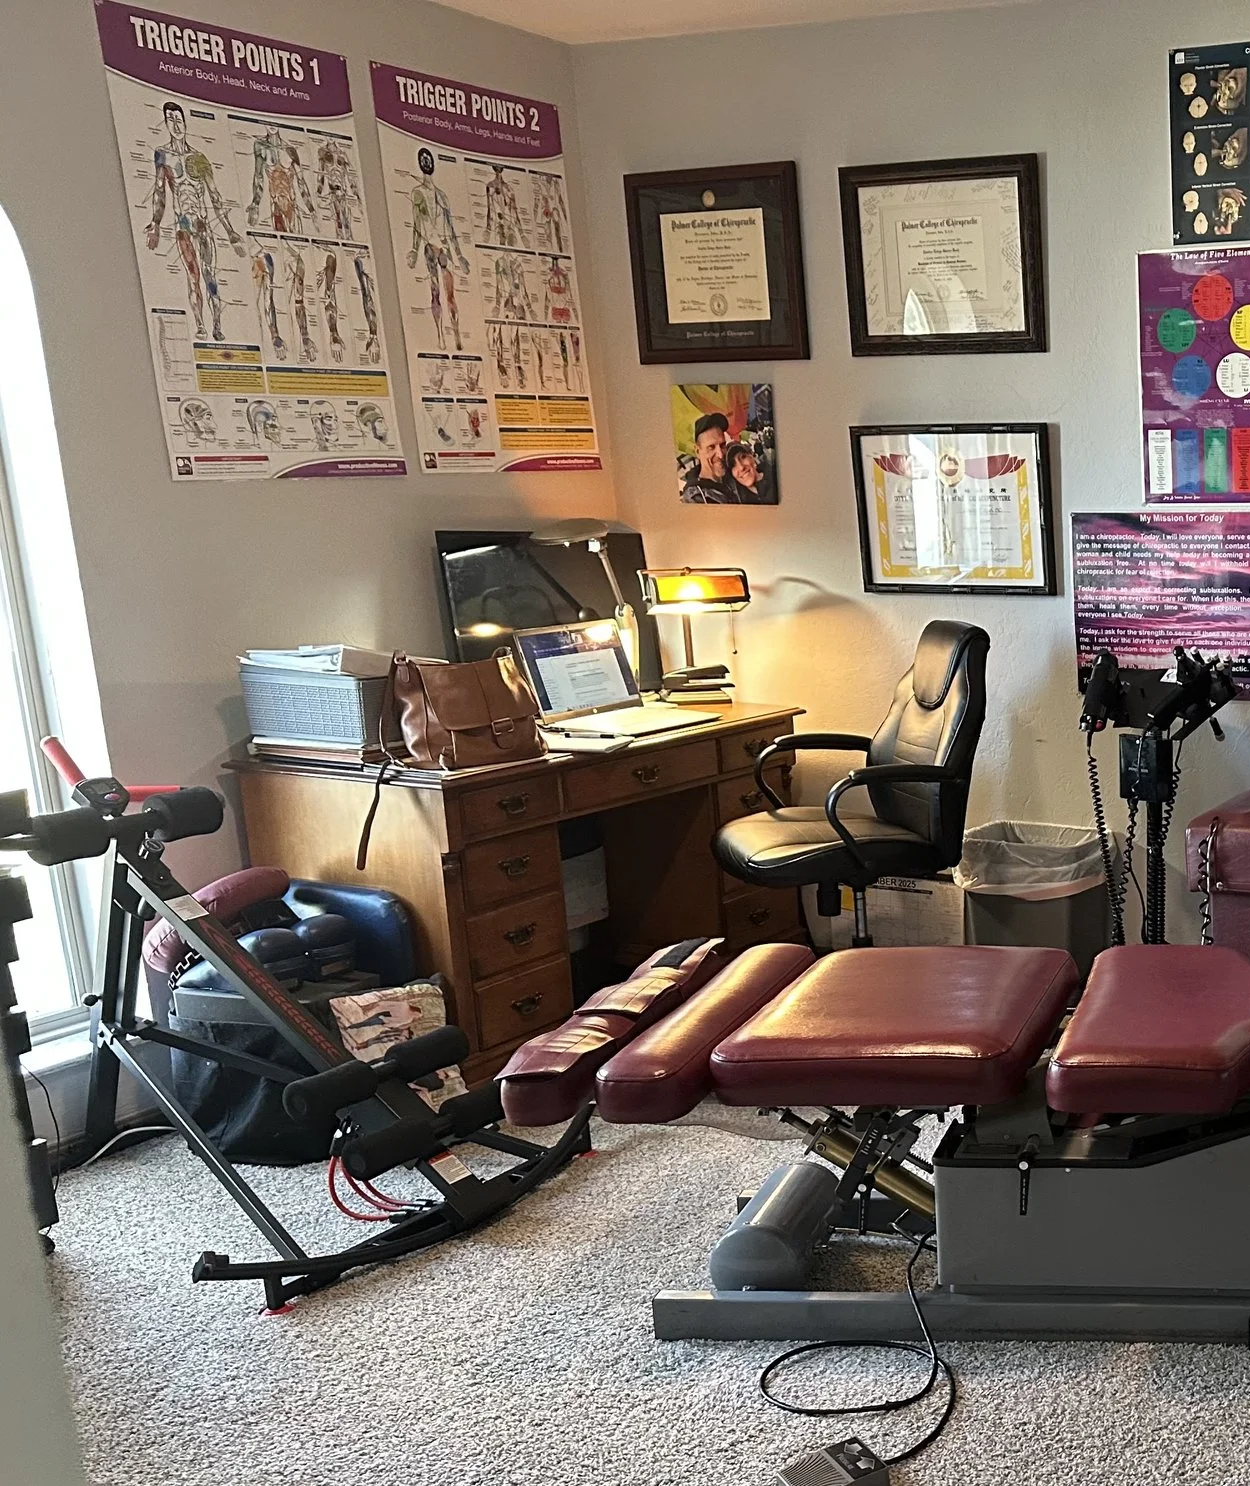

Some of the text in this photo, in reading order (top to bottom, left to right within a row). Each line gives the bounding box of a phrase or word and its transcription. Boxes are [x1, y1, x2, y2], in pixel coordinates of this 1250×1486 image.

[130, 16, 320, 85] TRIGGER POINTS 1
[159, 62, 193, 77] Anterior
[196, 69, 221, 83] Body,
[250, 80, 270, 92] Neck
[272, 84, 287, 96] and
[289, 88, 310, 100] Arms
[396, 75, 540, 131] TRIGGER POINTS 2
[402, 111, 432, 124] Posterior
[514, 133, 526, 144] and
[1200, 252, 1207, 260] of
[1140, 514, 1151, 523] My
[1153, 514, 1184, 522] Mission
[1200, 514, 1224, 523] Today
[899, 880, 916, 888] 2025
